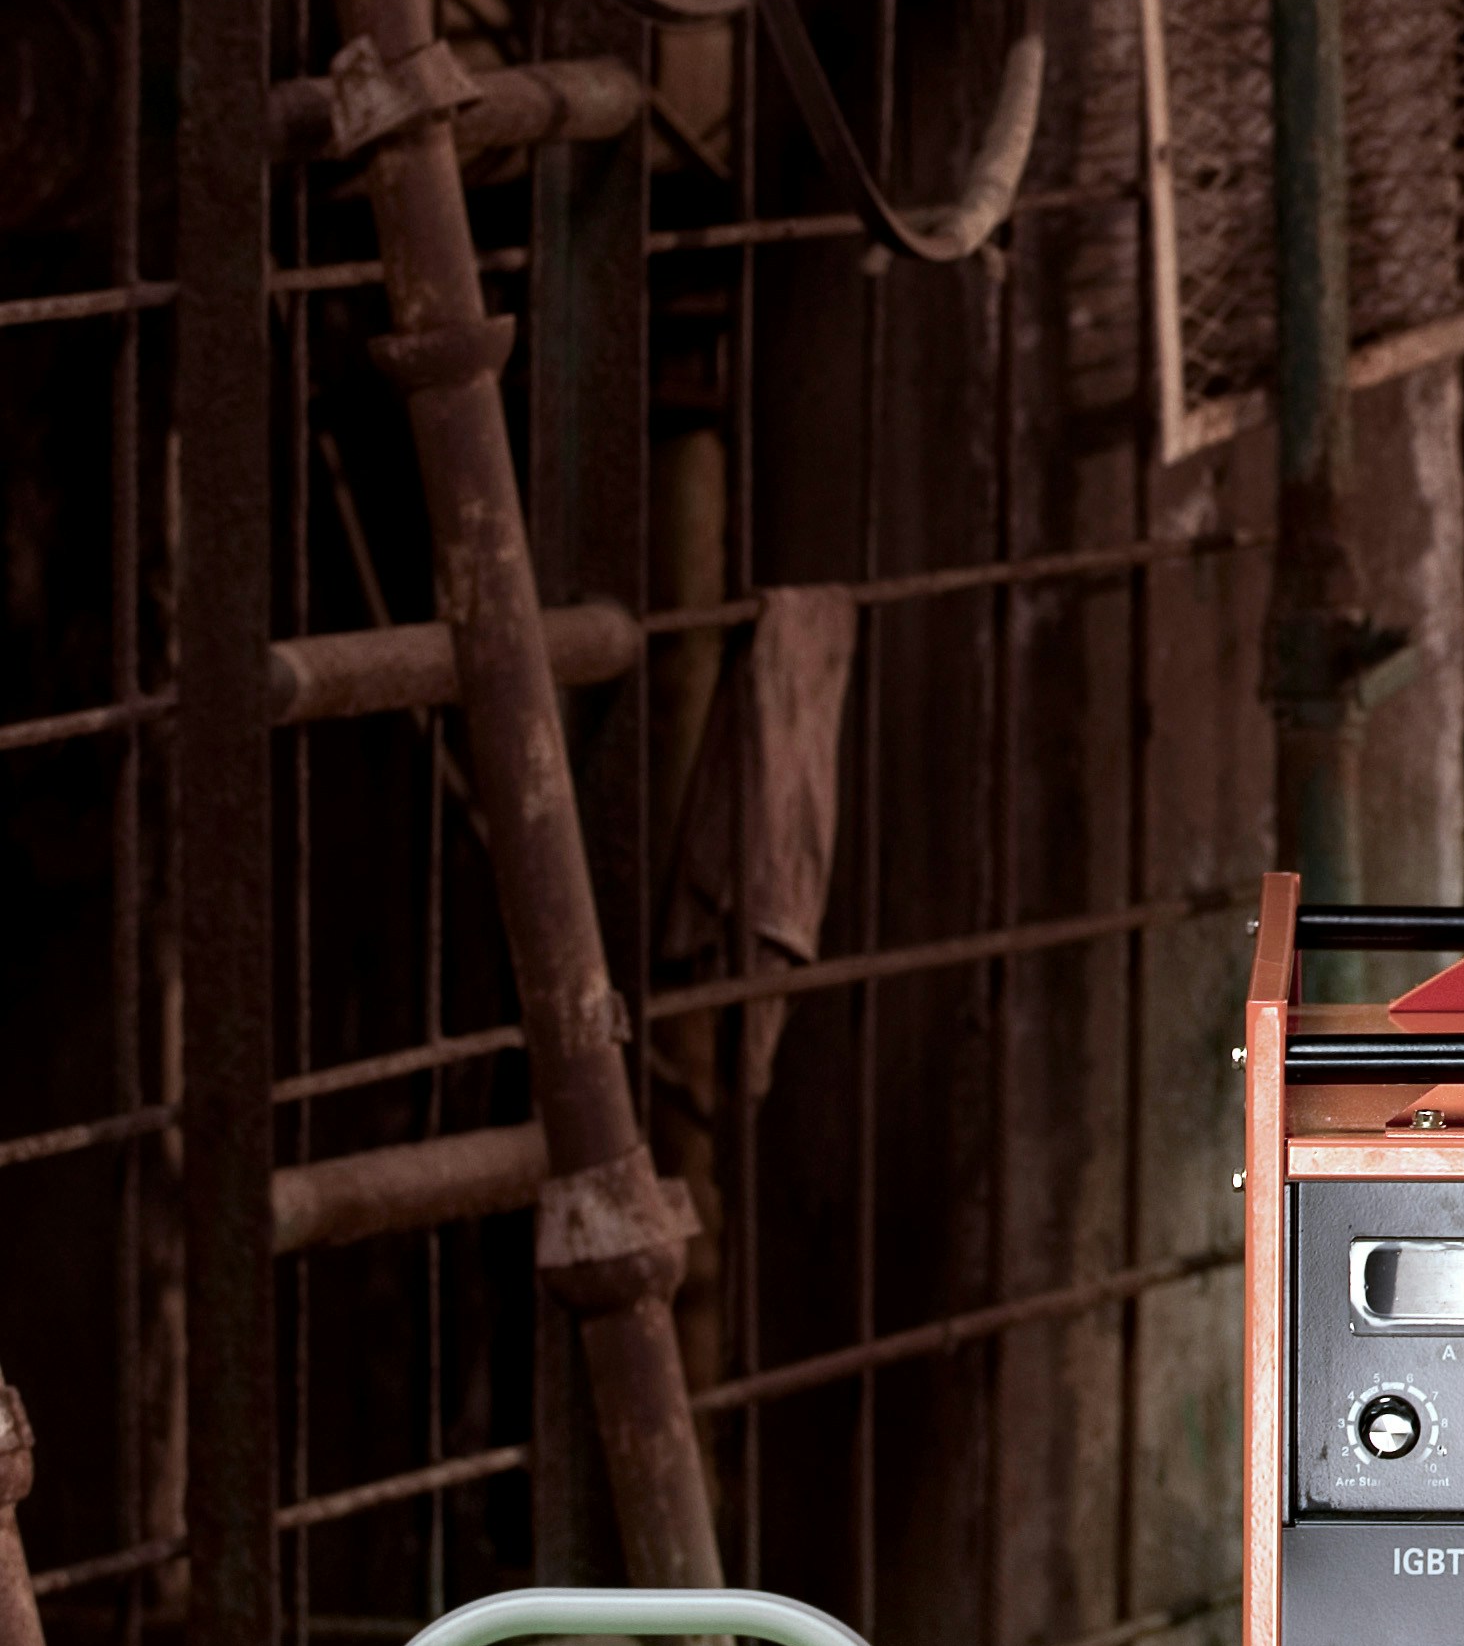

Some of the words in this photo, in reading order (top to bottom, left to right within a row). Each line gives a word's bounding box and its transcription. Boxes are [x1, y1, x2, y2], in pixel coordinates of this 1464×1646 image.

[1442, 1346, 1456, 1360] A
[1373, 1374, 1380, 1383] 5
[1406, 1374, 1414, 1383] 6
[1347, 1392, 1355, 1400] 4
[1432, 1392, 1439, 1400] 7
[1338, 1419, 1345, 1428] 3
[1441, 1419, 1448, 1428] 8
[1342, 1447, 1349, 1456] 2
[1336, 1477, 1356, 1487] Arc
[1359, 1477, 1381, 1487] Sta
[1393, 1548, 1464, 1576] IGBT
